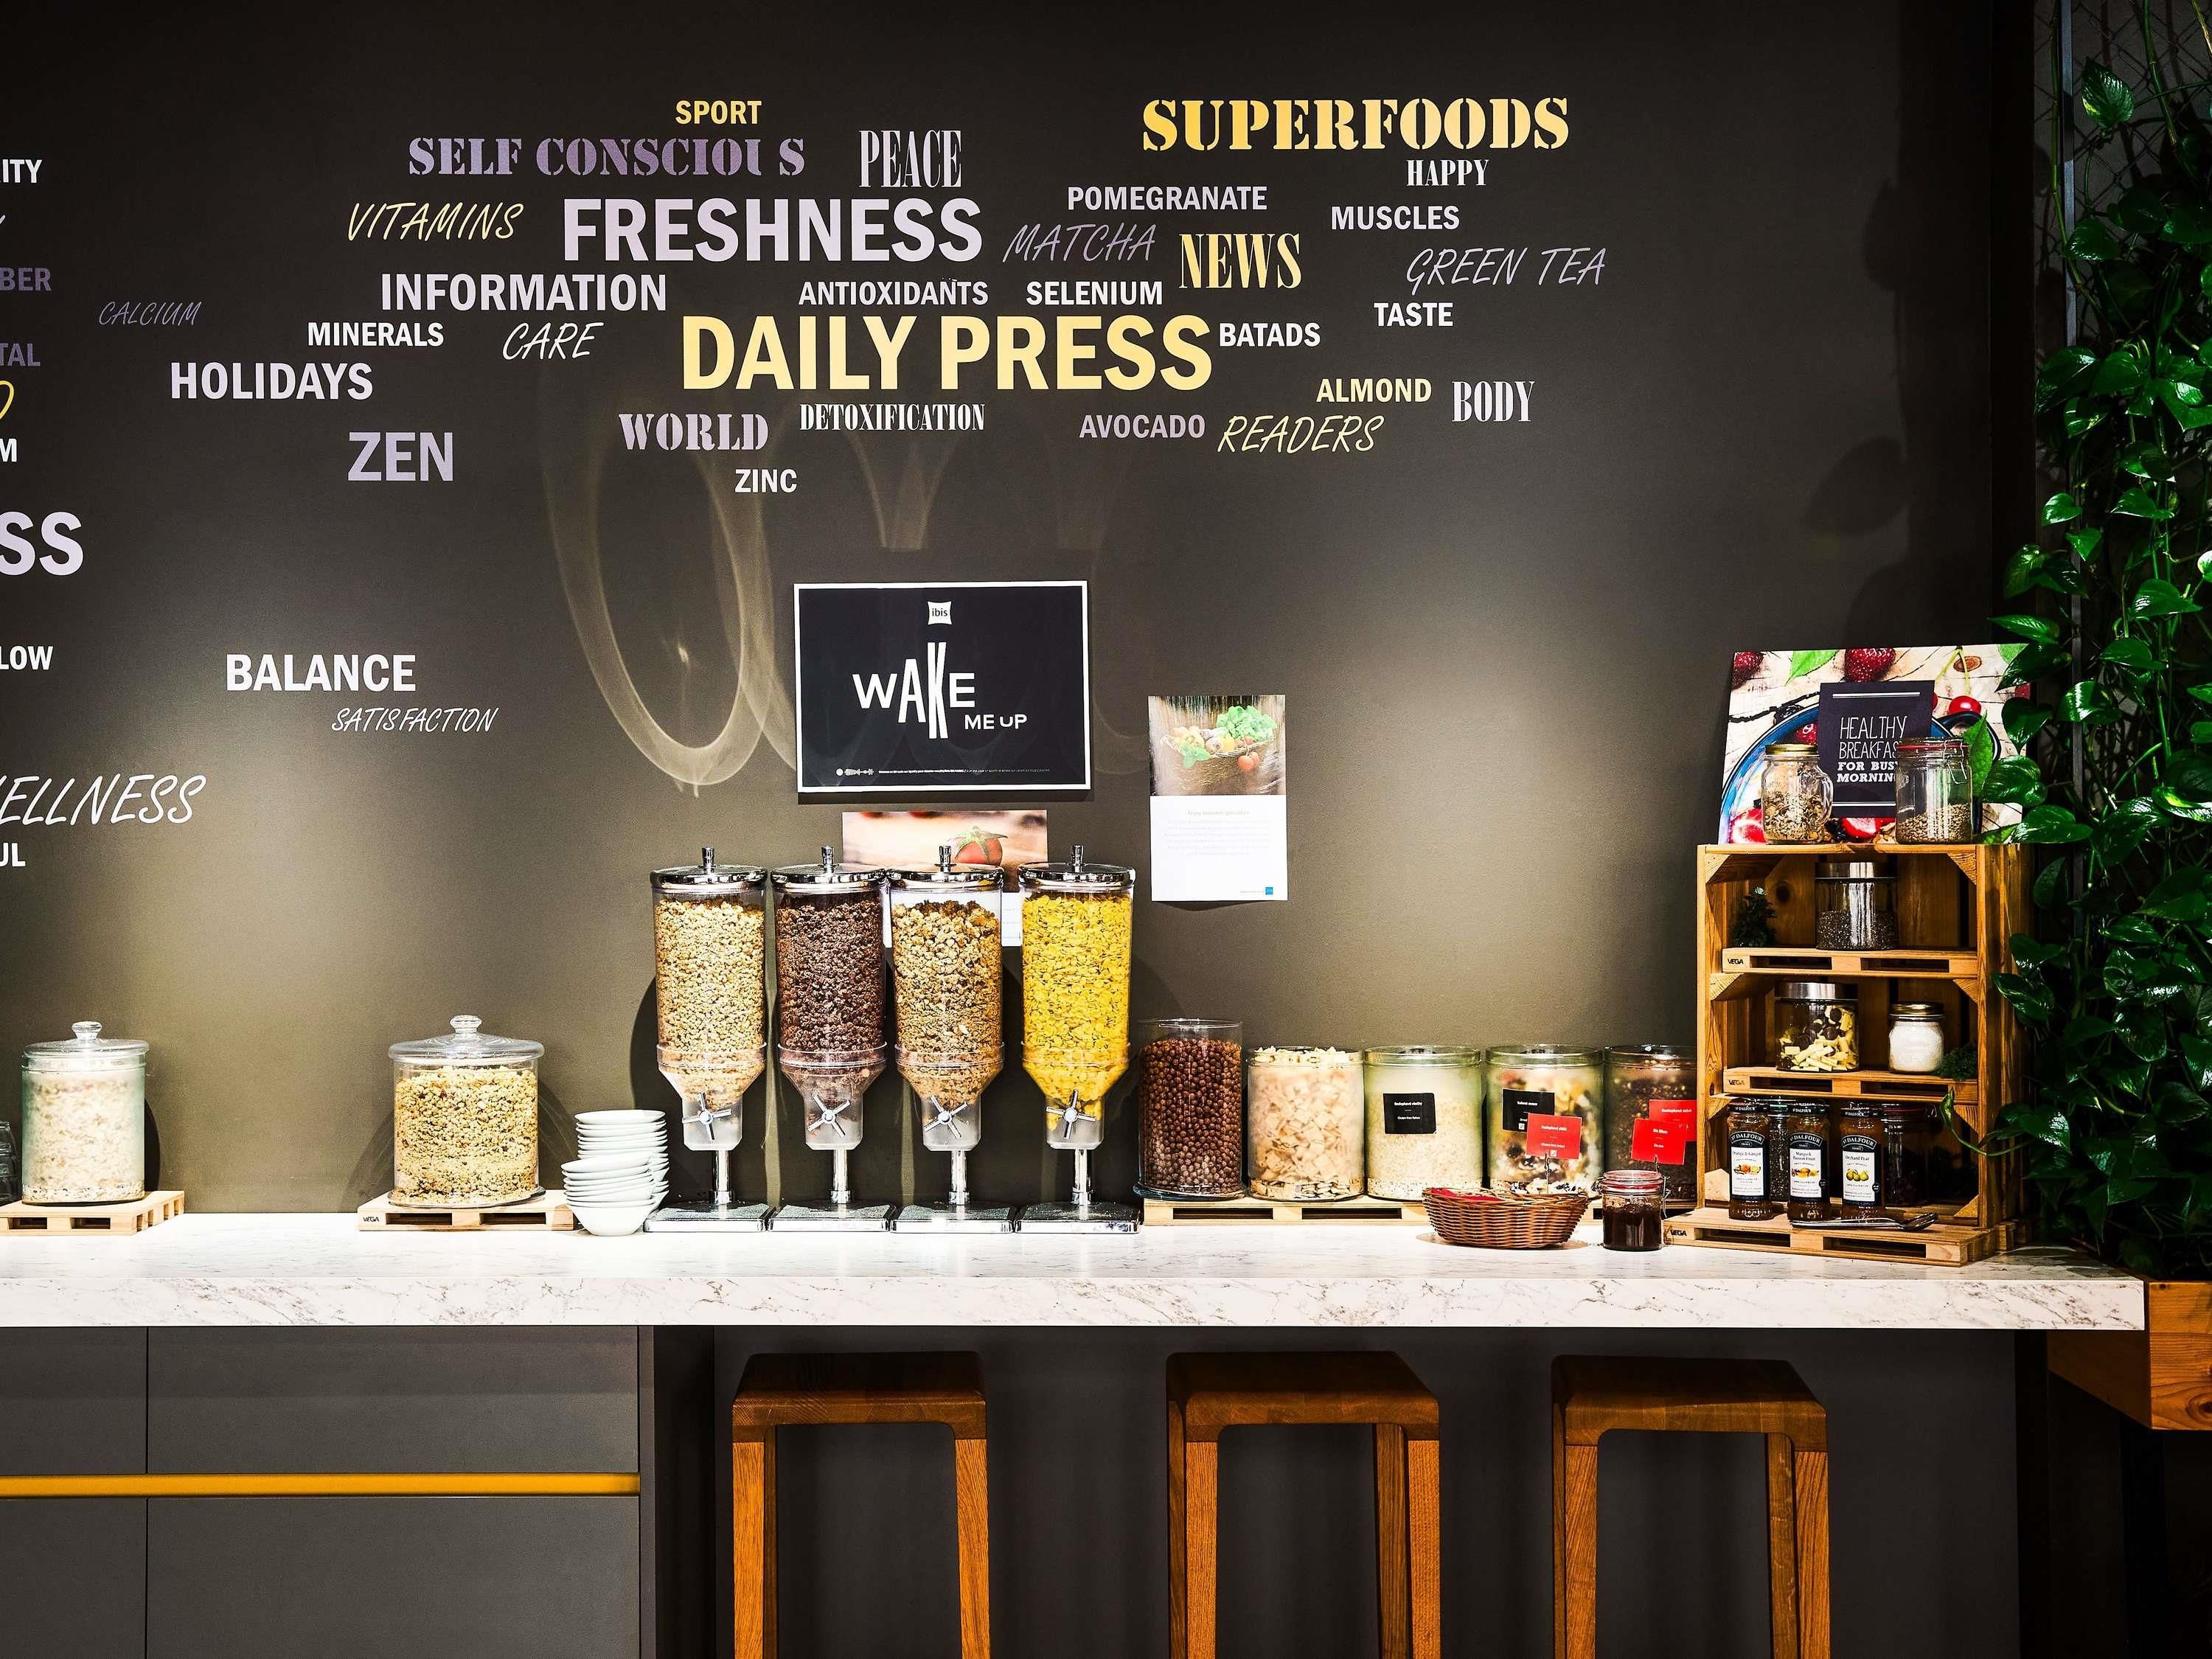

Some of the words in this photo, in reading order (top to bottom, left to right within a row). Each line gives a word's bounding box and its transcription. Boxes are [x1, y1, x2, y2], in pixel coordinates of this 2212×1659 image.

[675, 100, 762, 125] SPORT
[1143, 97, 1569, 151] SUPERFOODS
[408, 137, 522, 175] SELF
[858, 129, 961, 188] PEACE
[0, 159, 43, 184] ITY
[1406, 159, 1489, 187] HAPPY
[1068, 186, 1267, 211] POMEGRANATE
[348, 201, 524, 242] VITAMINS
[564, 198, 982, 262] FRESHNESS
[1332, 205, 1460, 230] MUSCLES
[1002, 222, 1156, 263] MATCHA
[1178, 232, 1301, 289] NEWS
[1406, 247, 1528, 296] GREEN
[1538, 247, 1607, 286] TEA
[382, 273, 666, 311] INFORMATION
[798, 280, 989, 305] ANTIOXIDANTS
[1026, 281, 1163, 306] SELENIUM
[99, 301, 202, 326] CALCIUM
[1373, 302, 1453, 327] TASTE
[307, 321, 444, 347] MINERALS
[502, 321, 605, 361] CARE
[1220, 322, 1321, 347] BATADS
[683, 316, 917, 390] DAILY
[941, 314, 1212, 391] PRESS
[171, 361, 373, 400] HOLIDAYS
[1315, 378, 1432, 403] ALMOND
[1451, 380, 1535, 422] BODY
[799, 403, 986, 431] DETOXIFICATION
[1079, 414, 1206, 439] AVOCADO
[618, 413, 768, 451] WORLD
[1217, 414, 1385, 454] READERS
[347, 431, 453, 481] ZEN
[734, 468, 797, 493] ZINC
[931, 608, 948, 617] ibis
[226, 653, 417, 693] BALANCE
[852, 641, 975, 739] WAKE
[331, 707, 499, 733] SATISFACTION
[964, 714, 995, 730] ME
[999, 714, 1027, 729] UP
[1840, 715, 1907, 739] HEALTHY
[1839, 741, 1899, 759] BREAKFAS
[1836, 773, 1896, 782] MORNIN
[1837, 761, 1865, 771] FOR
[0, 773, 207, 826] ELLNESS
